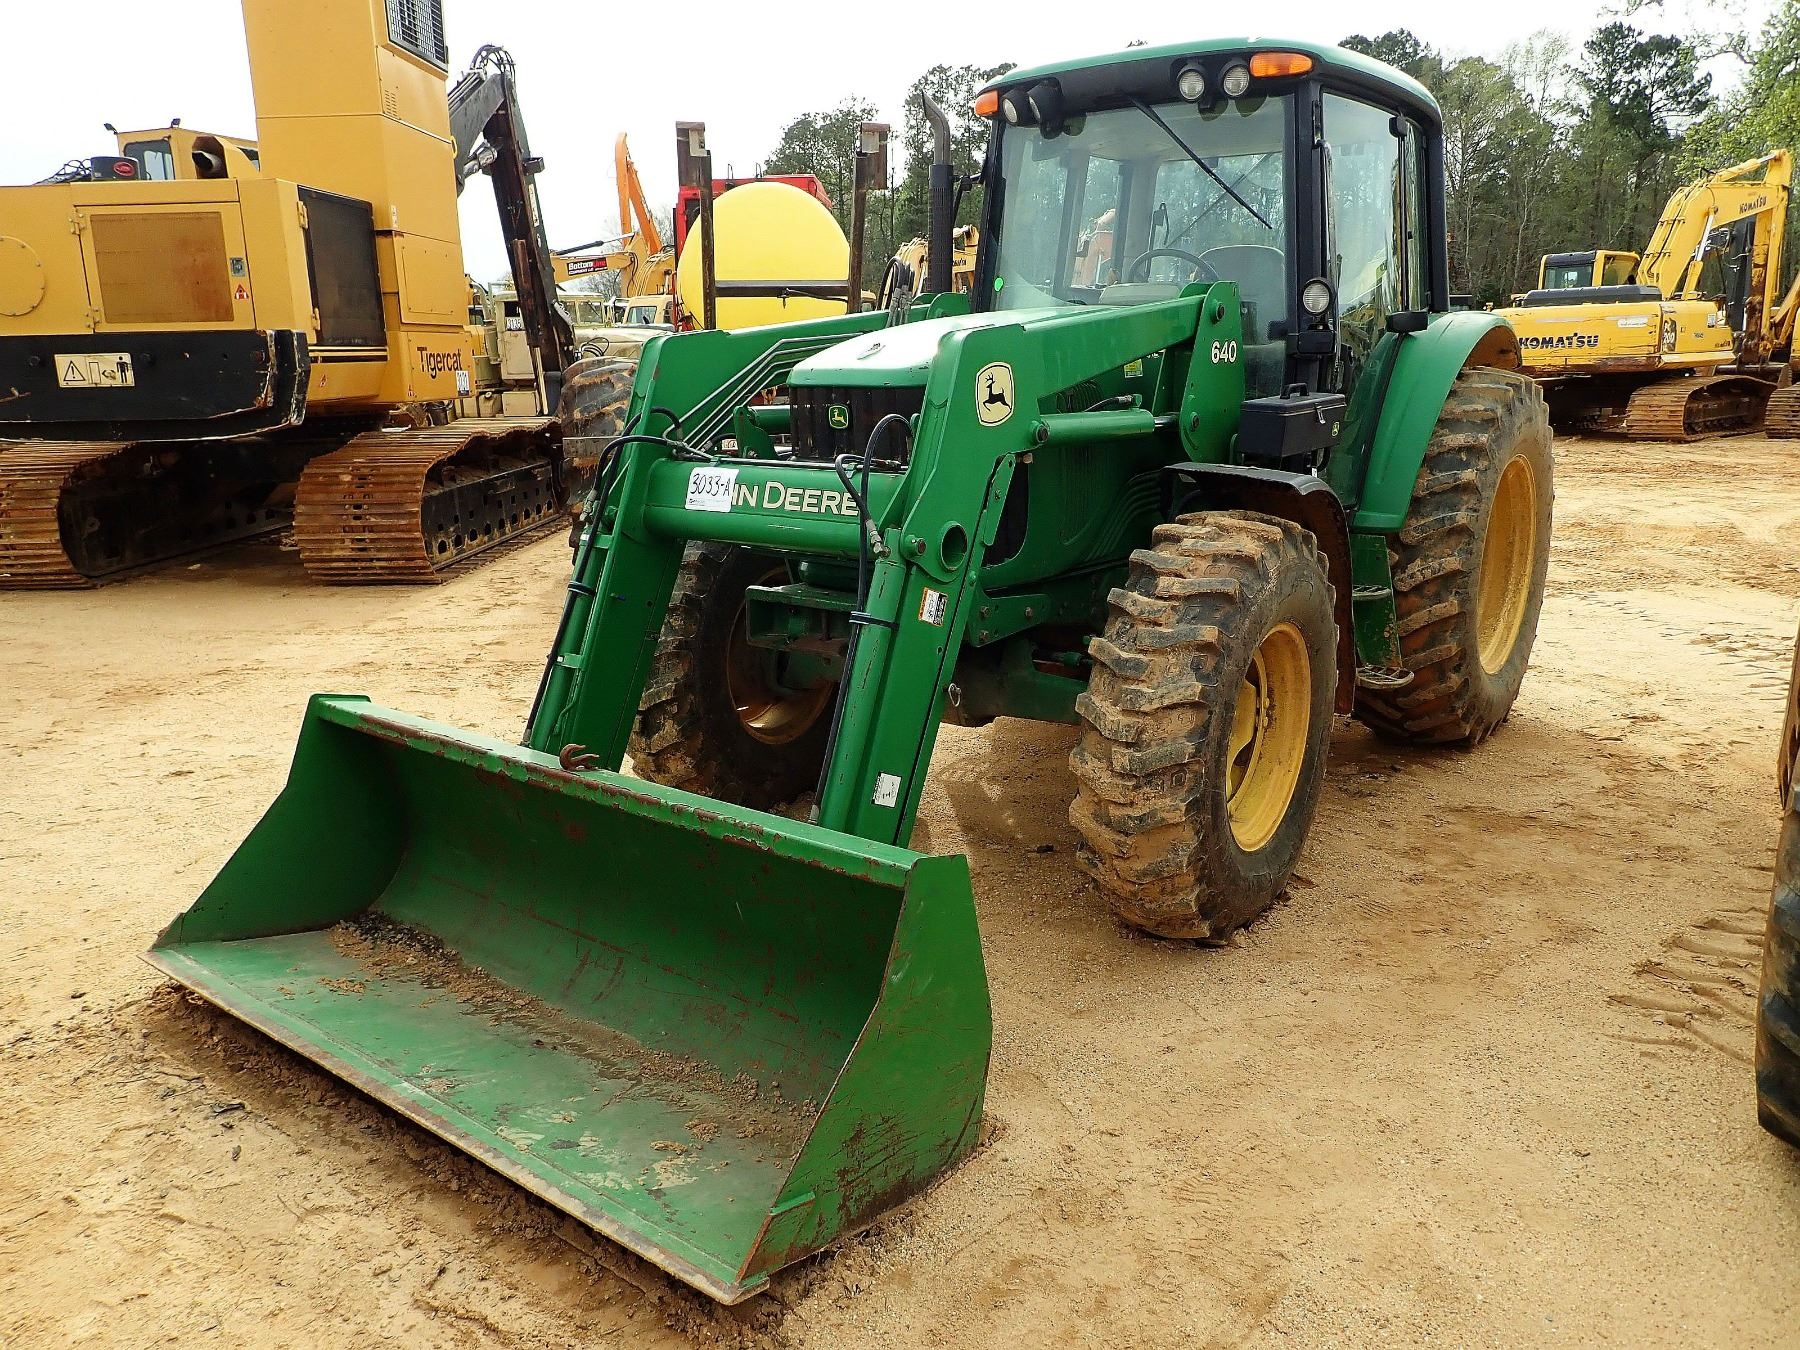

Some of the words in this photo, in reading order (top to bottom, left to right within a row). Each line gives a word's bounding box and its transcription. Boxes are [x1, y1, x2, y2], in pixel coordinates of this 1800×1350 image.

[1211, 341, 1237, 364] 640
[1519, 333, 1599, 349] KOMATSU
[417, 346, 462, 379] Tigercat
[690, 473, 730, 497] 3033-A
[762, 481, 859, 516] DEERE
